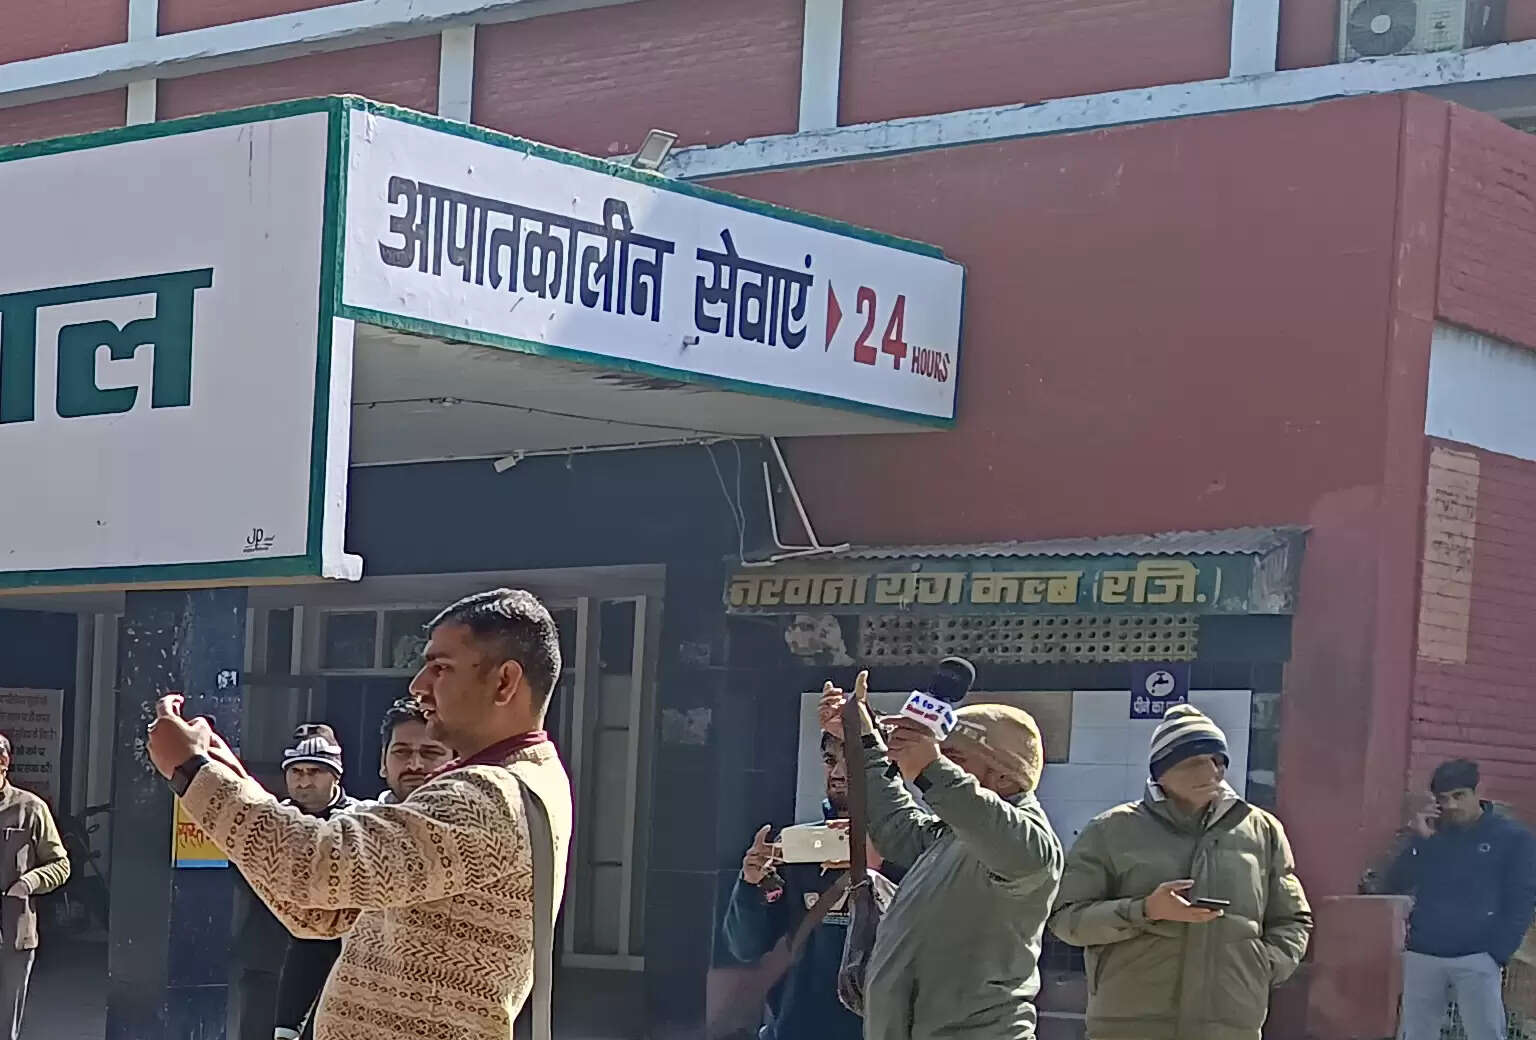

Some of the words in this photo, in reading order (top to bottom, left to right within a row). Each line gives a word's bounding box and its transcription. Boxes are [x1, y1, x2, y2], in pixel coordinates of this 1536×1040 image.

[378, 174, 676, 323] आपातकालीन
[694, 228, 816, 350] सेवाएं
[854, 285, 909, 371] 24
[911, 344, 952, 384] HOURS
[727, 572, 873, 607] नरवाना
